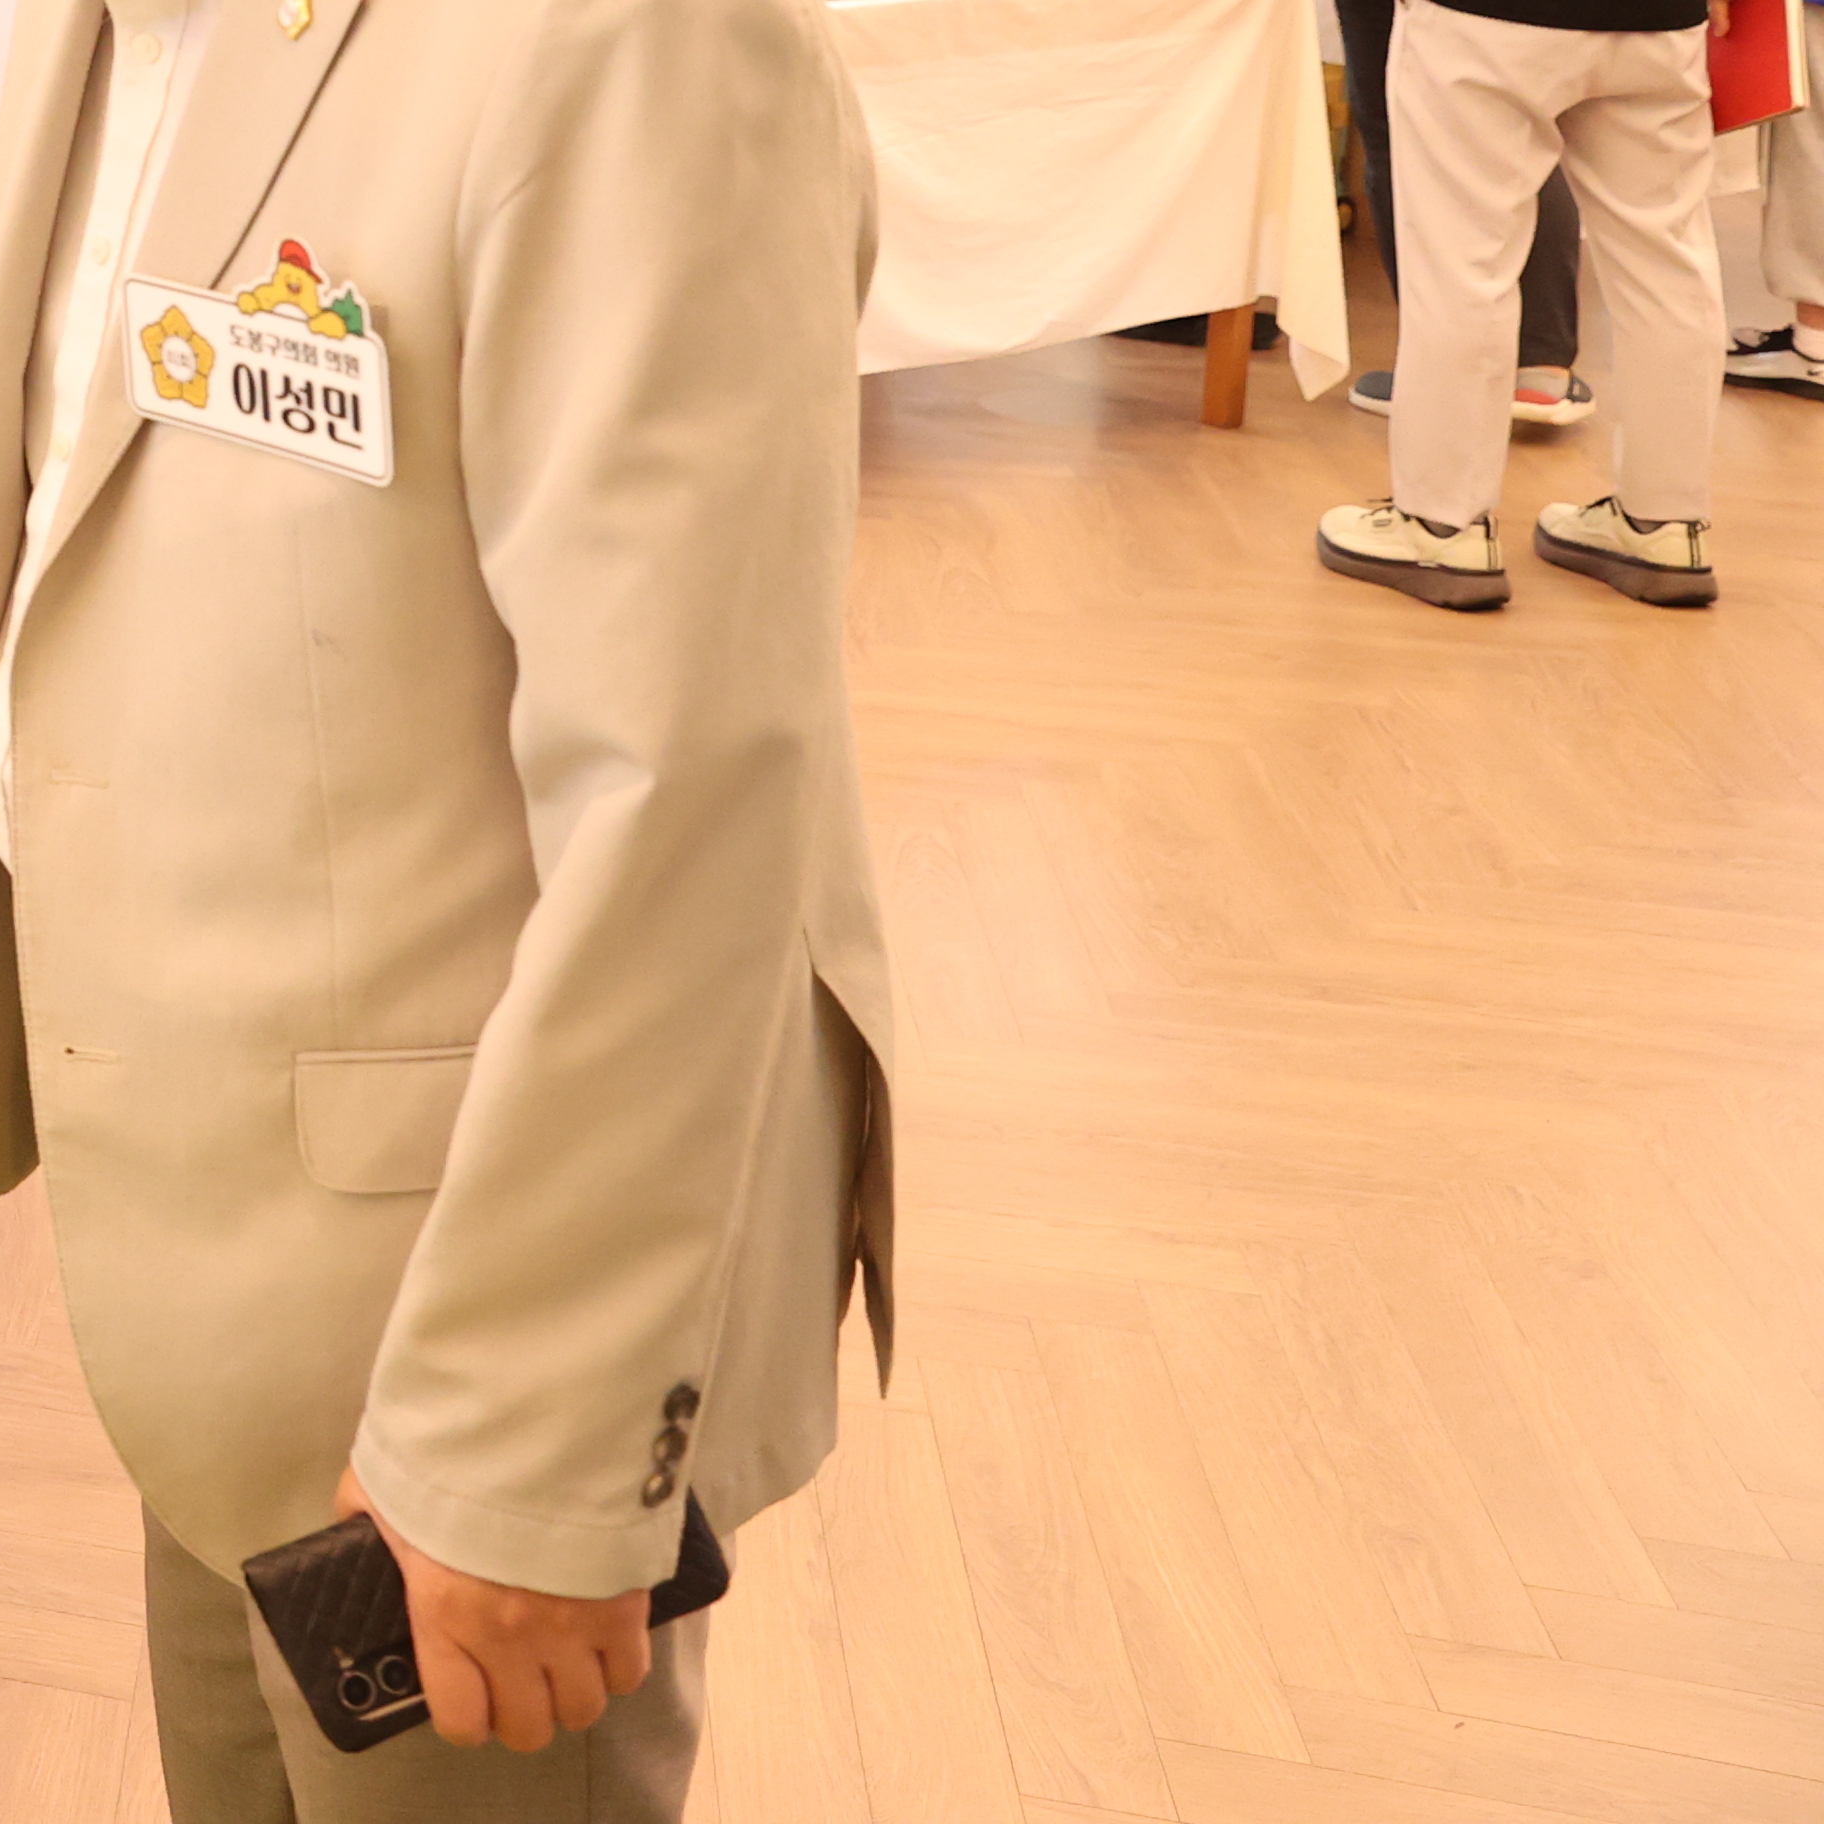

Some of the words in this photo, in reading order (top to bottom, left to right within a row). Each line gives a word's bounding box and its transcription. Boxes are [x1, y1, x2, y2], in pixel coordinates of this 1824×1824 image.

[229, 324, 318, 368] 도봉구의회
[324, 347, 360, 381] 의원
[232, 363, 364, 450] 이성민
